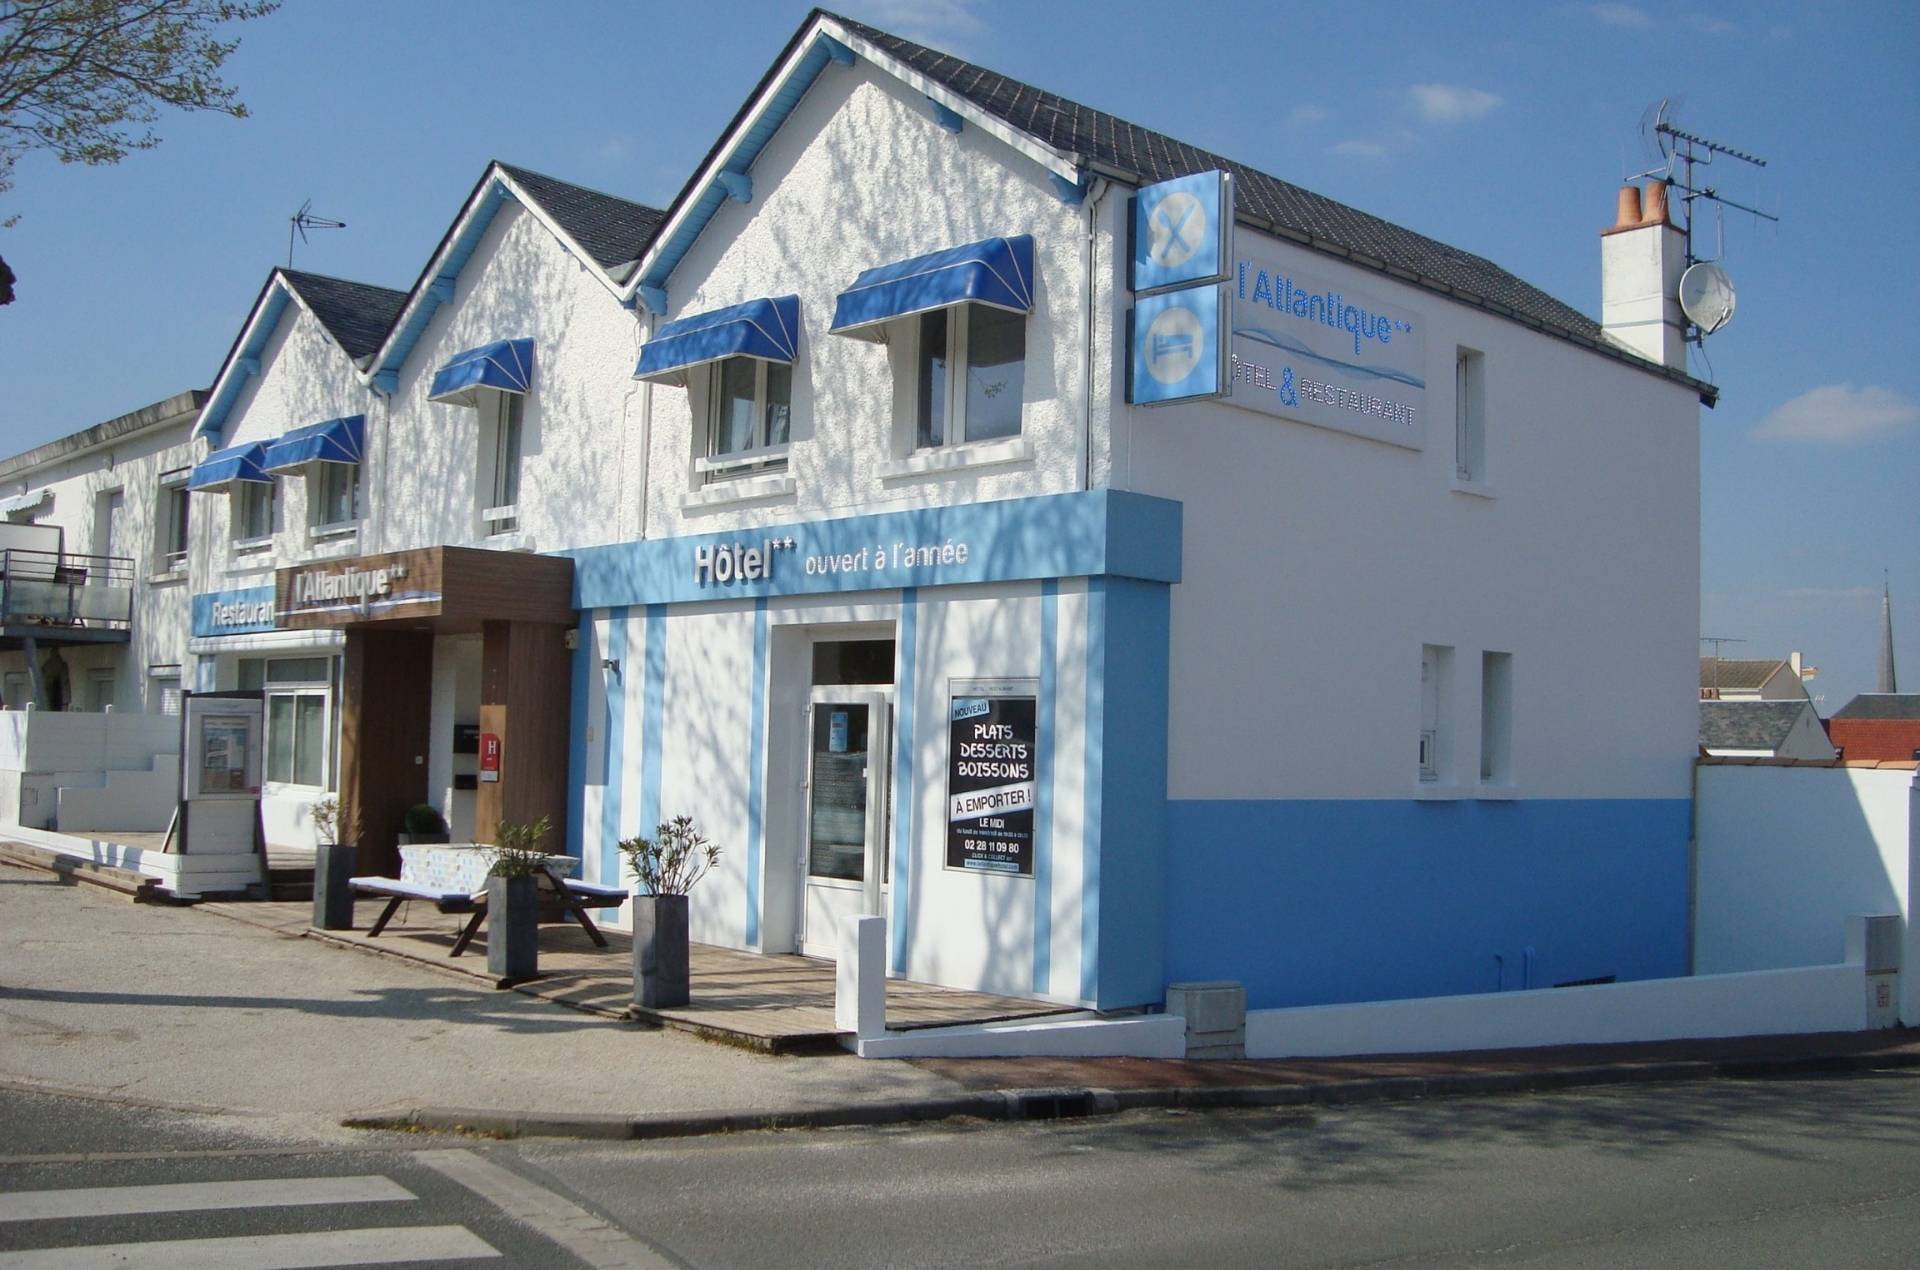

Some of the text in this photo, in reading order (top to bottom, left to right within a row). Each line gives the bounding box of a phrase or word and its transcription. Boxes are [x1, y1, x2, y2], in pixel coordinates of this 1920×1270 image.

[1239, 261, 1393, 355] l'Atlantique
[1232, 353, 1416, 426] ÔTEL & RESTAURANT
[694, 537, 969, 582] Hôtel ouvert à l'année
[295, 566, 389, 615] l'Atlantique
[212, 600, 275, 627] Restauran
[954, 704, 987, 717] NOUVEAU
[974, 723, 1014, 740] PLATS
[488, 740, 497, 755] H
[959, 742, 1028, 760] DESSERTS
[957, 761, 1029, 779] BOISSONS
[956, 797, 964, 814] À
[966, 790, 1025, 812] EMPORTER
[979, 817, 1005, 829] LE MIDI
[964, 839, 1020, 854] 02 28 11 09 80
